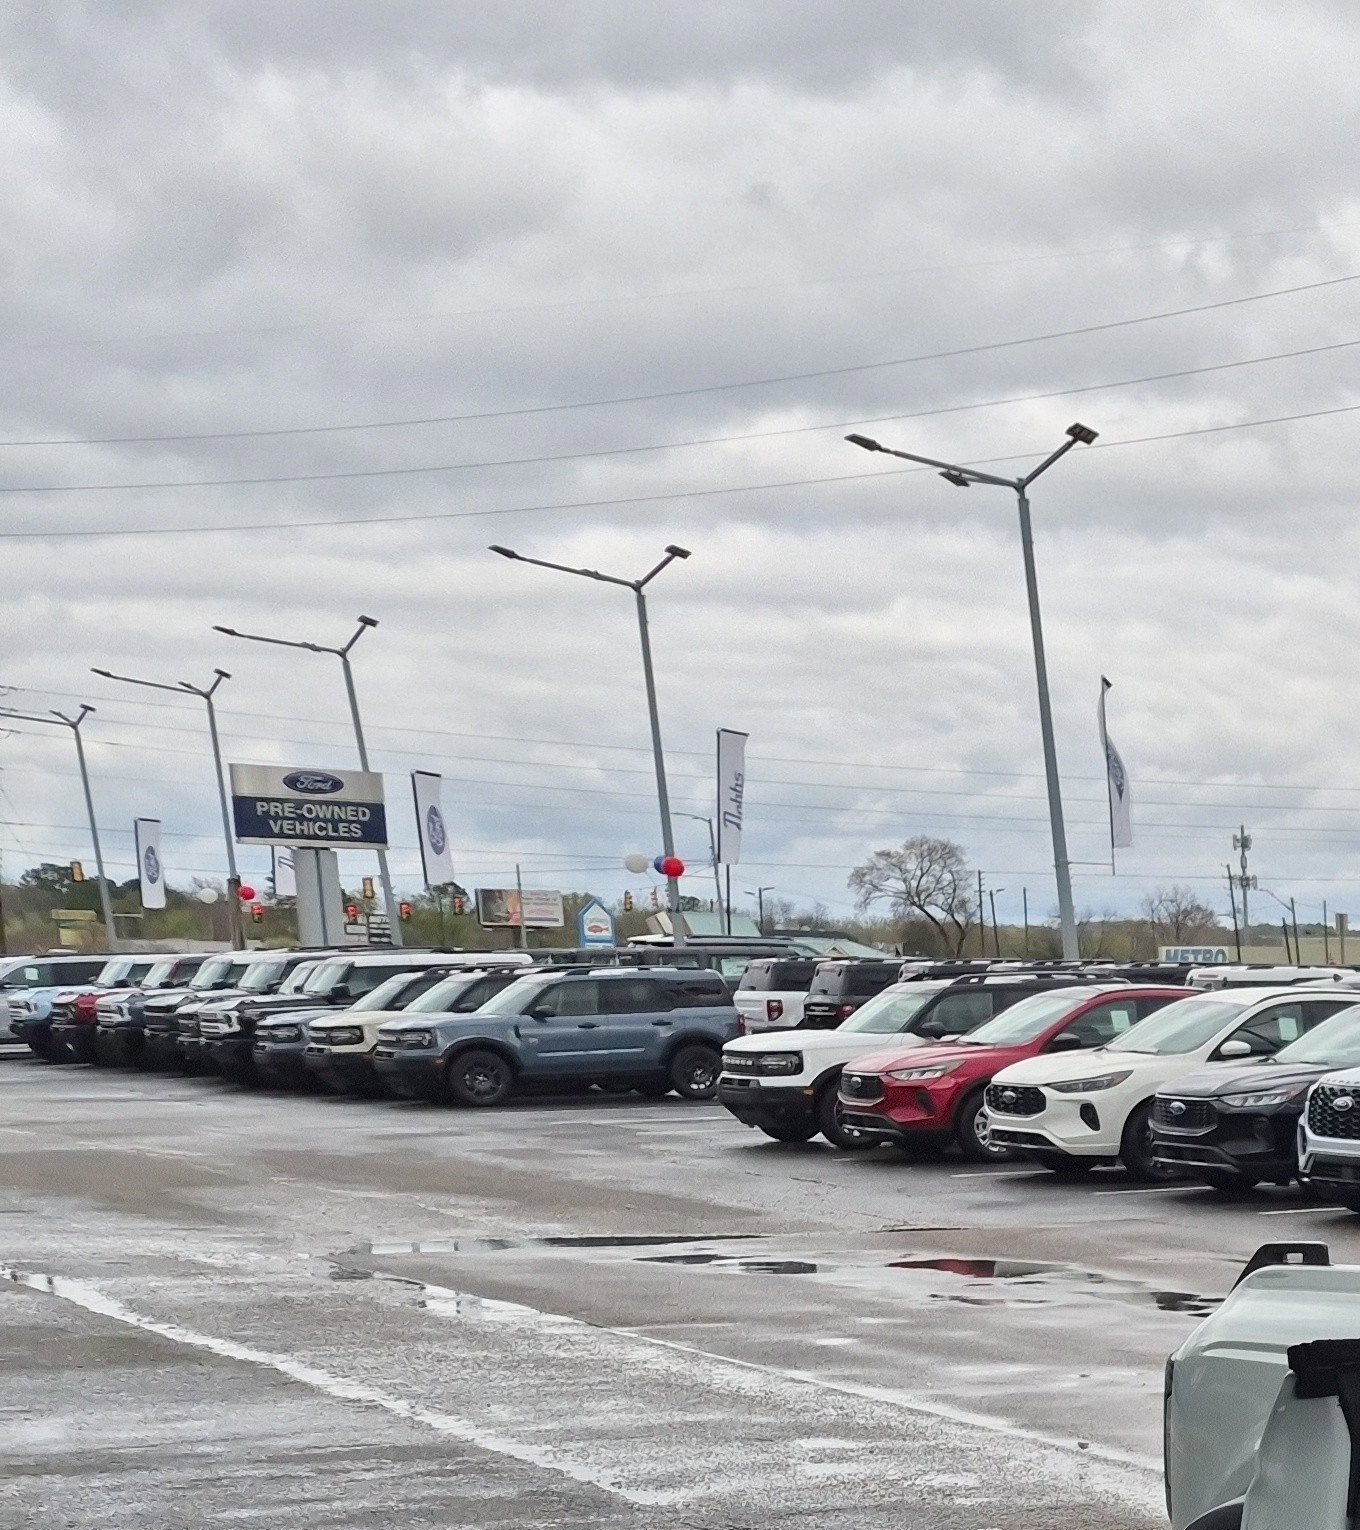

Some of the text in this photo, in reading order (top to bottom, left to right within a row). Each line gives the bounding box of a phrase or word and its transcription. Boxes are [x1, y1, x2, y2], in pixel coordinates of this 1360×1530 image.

[296, 775, 333, 791] Ford
[255, 801, 371, 822] PRE-OWNED
[269, 820, 363, 838] VEHICLES
